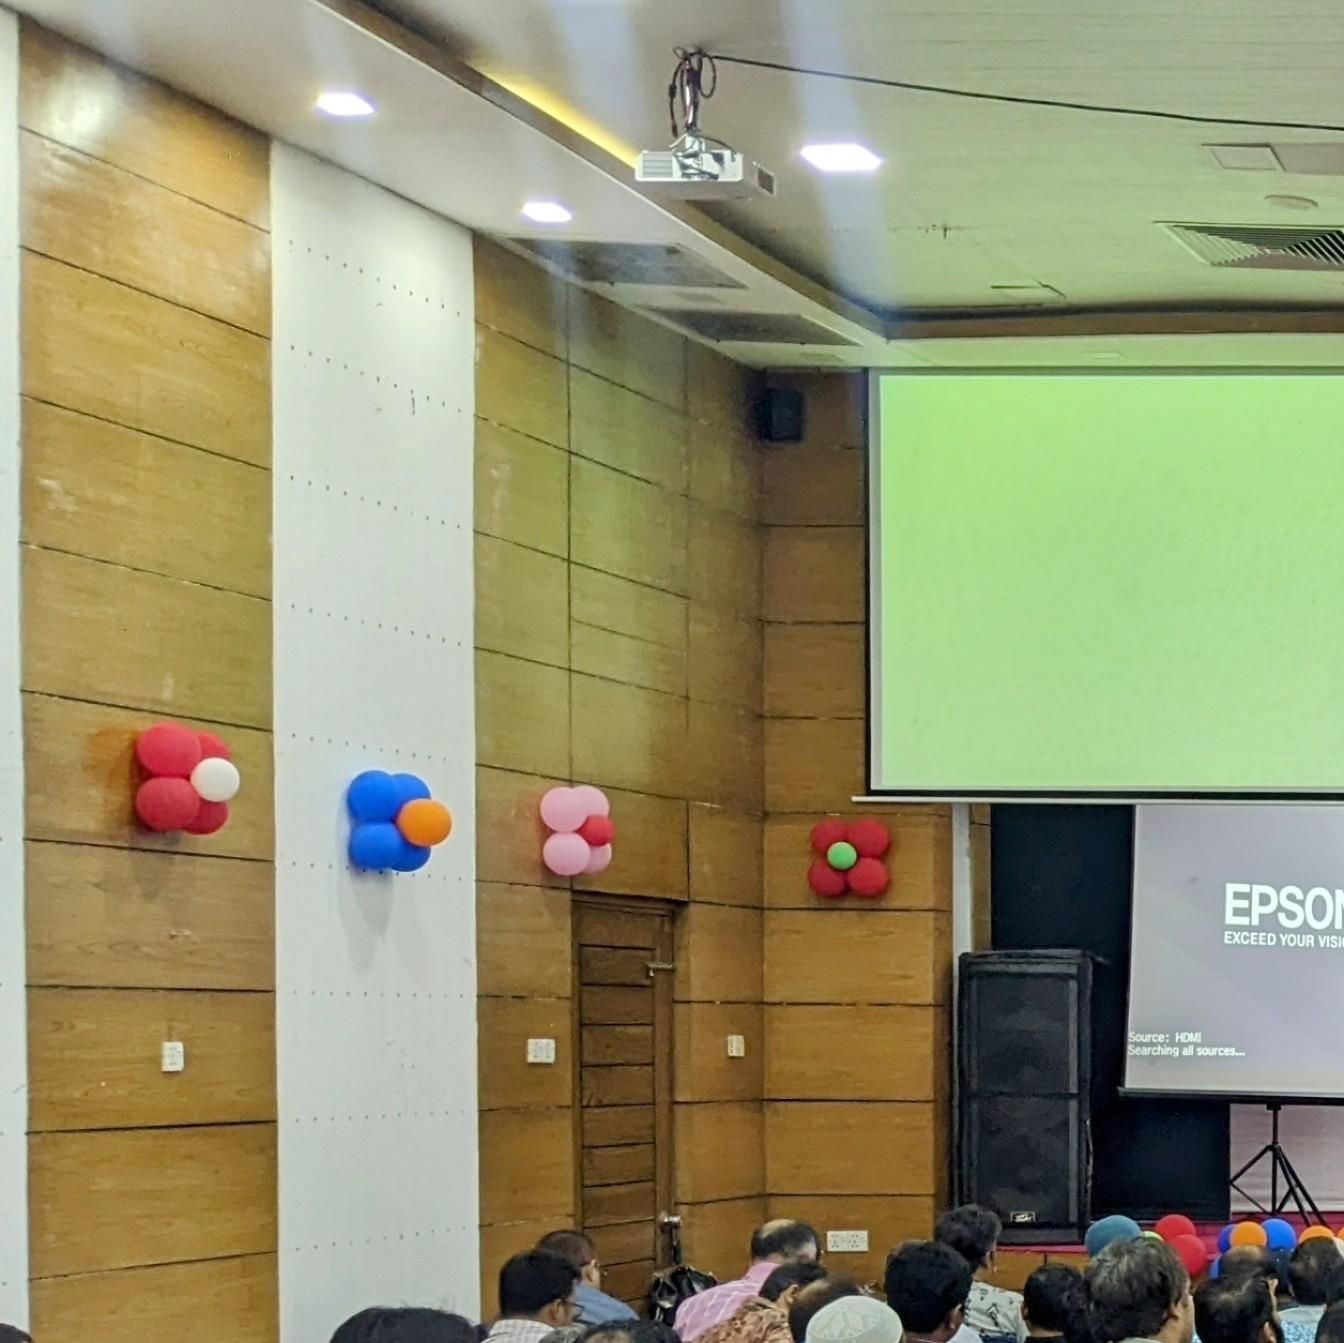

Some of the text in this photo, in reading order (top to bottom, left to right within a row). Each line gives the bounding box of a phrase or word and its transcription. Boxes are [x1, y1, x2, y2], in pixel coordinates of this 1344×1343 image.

[1224, 931, 1276, 946] EXCEED
[1280, 933, 1315, 948] YOUR
[1128, 1032, 1202, 1043] Source: HDMI
[1127, 1044, 1246, 1058] Searching all sources...
